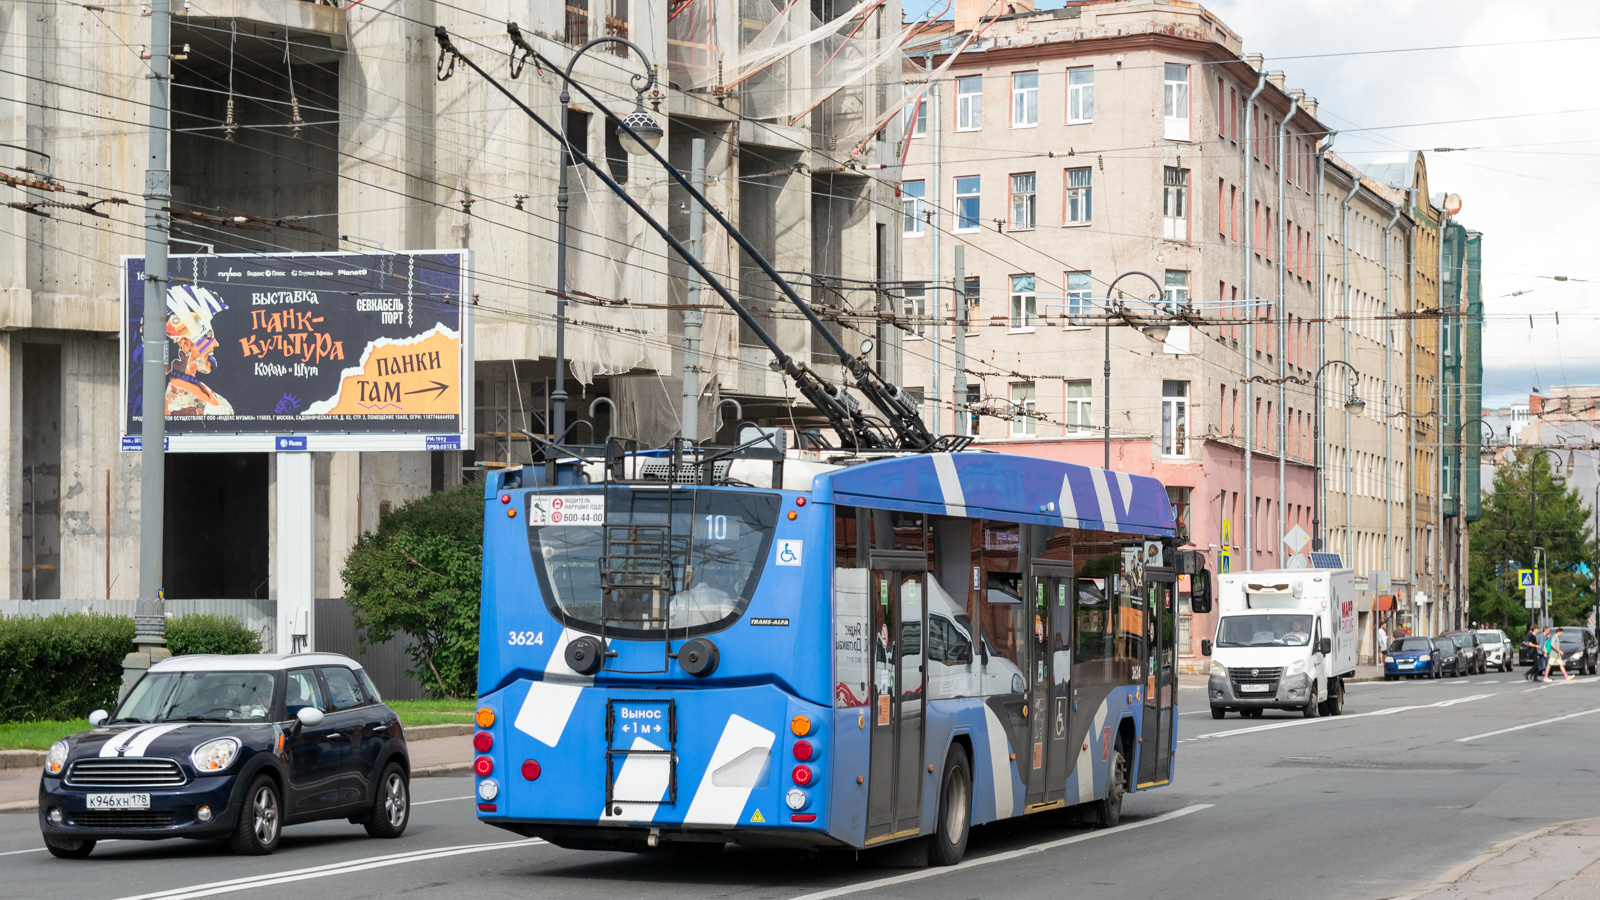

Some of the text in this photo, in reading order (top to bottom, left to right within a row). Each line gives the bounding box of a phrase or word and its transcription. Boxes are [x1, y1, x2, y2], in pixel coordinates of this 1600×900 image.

[251, 290, 319, 305] ВЫСТАВКА
[356, 298, 404, 312] СЕВКАБЕЛЬ
[250, 308, 325, 332] ПАНК-
[381, 311, 403, 325] ПОРТ
[238, 332, 345, 365] КУЛЬТУРА
[376, 350, 442, 376] ПАНКИ
[356, 380, 402, 403] ТАМ
[563, 513, 603, 522] 600-44-00
[705, 514, 727, 540] 10
[508, 631, 544, 646] 3624
[621, 707, 662, 719] Вынос
[632, 721, 638, 734] 1
[131, 794, 147, 804] 178
